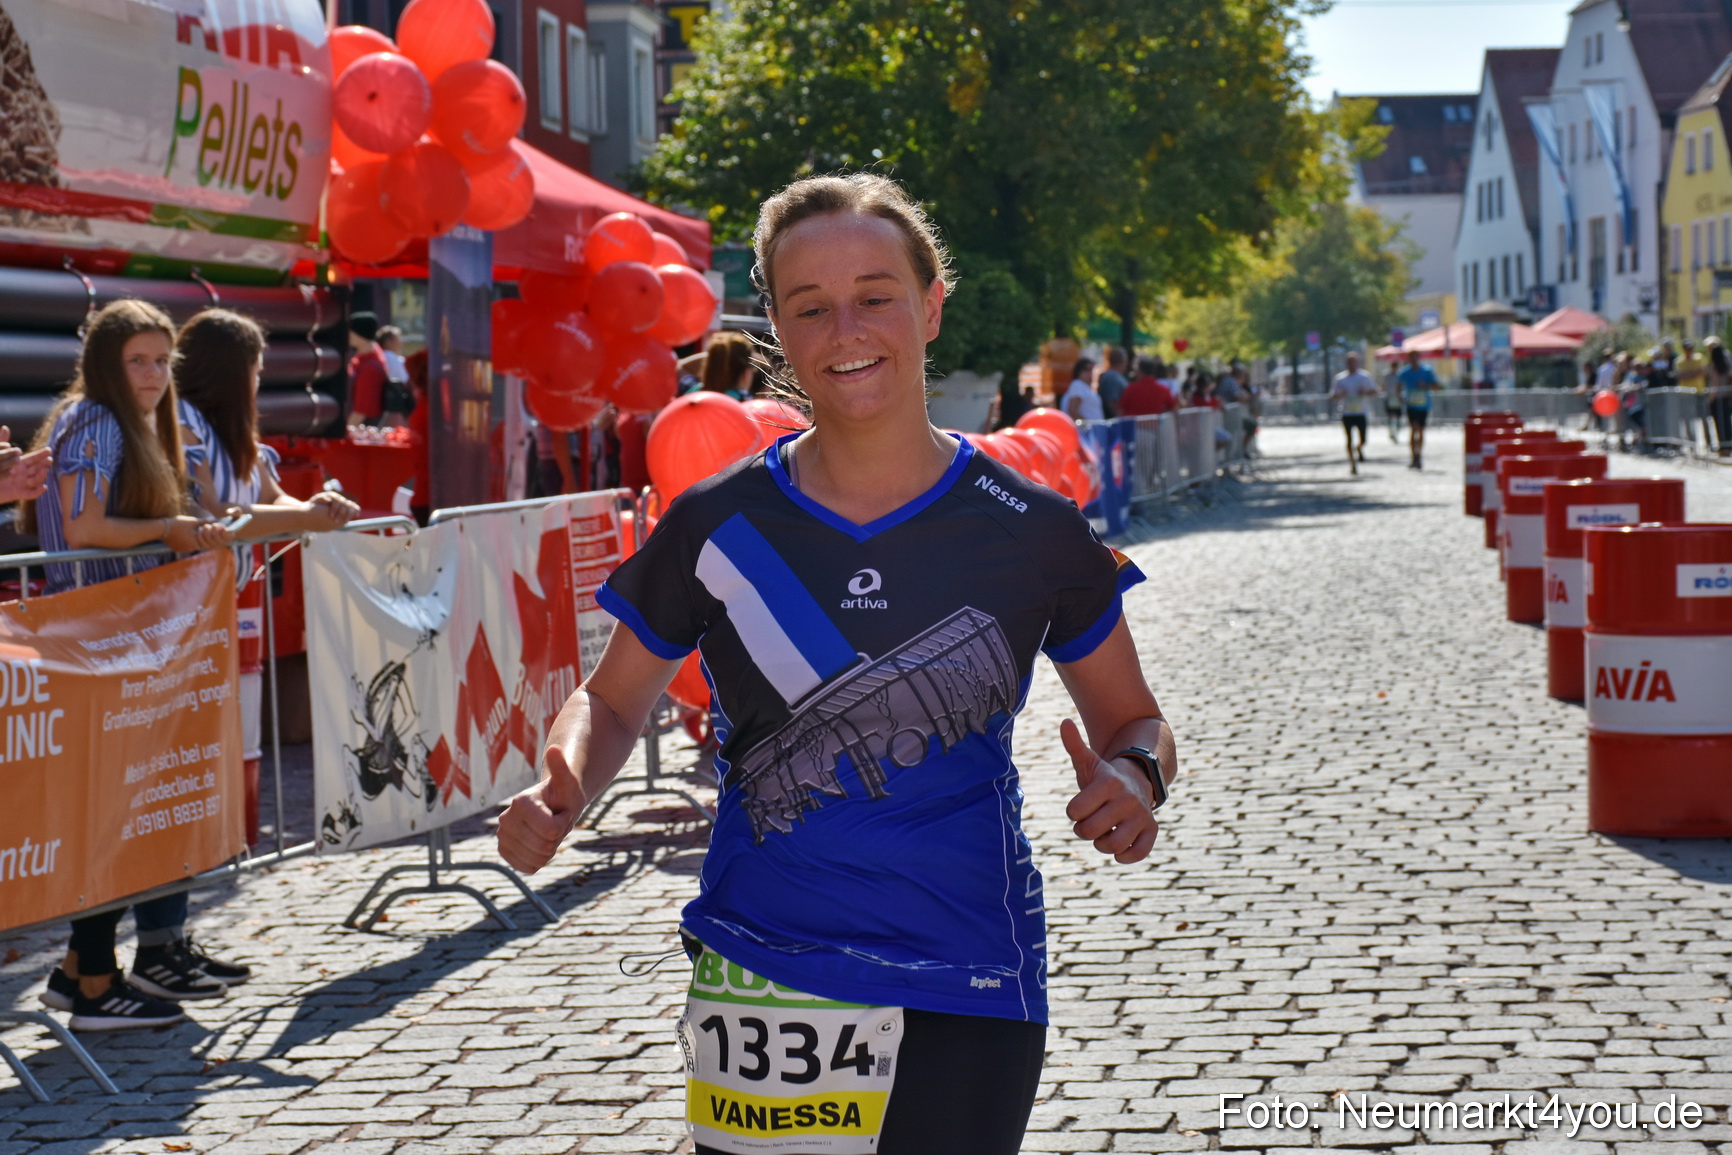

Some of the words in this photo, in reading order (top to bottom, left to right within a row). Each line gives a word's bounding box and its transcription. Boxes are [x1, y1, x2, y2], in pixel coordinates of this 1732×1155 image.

[163, 65, 302, 202] Pellets
[974, 474, 1028, 513] Nessa
[840, 597, 888, 609] artiva
[0, 708, 64, 764] INIC
[179, 744, 201, 765] bei
[136, 808, 173, 836] 09181
[172, 799, 205, 825] 8833
[699, 1014, 876, 1085] 1334
[710, 1094, 862, 1131] VANESSA
